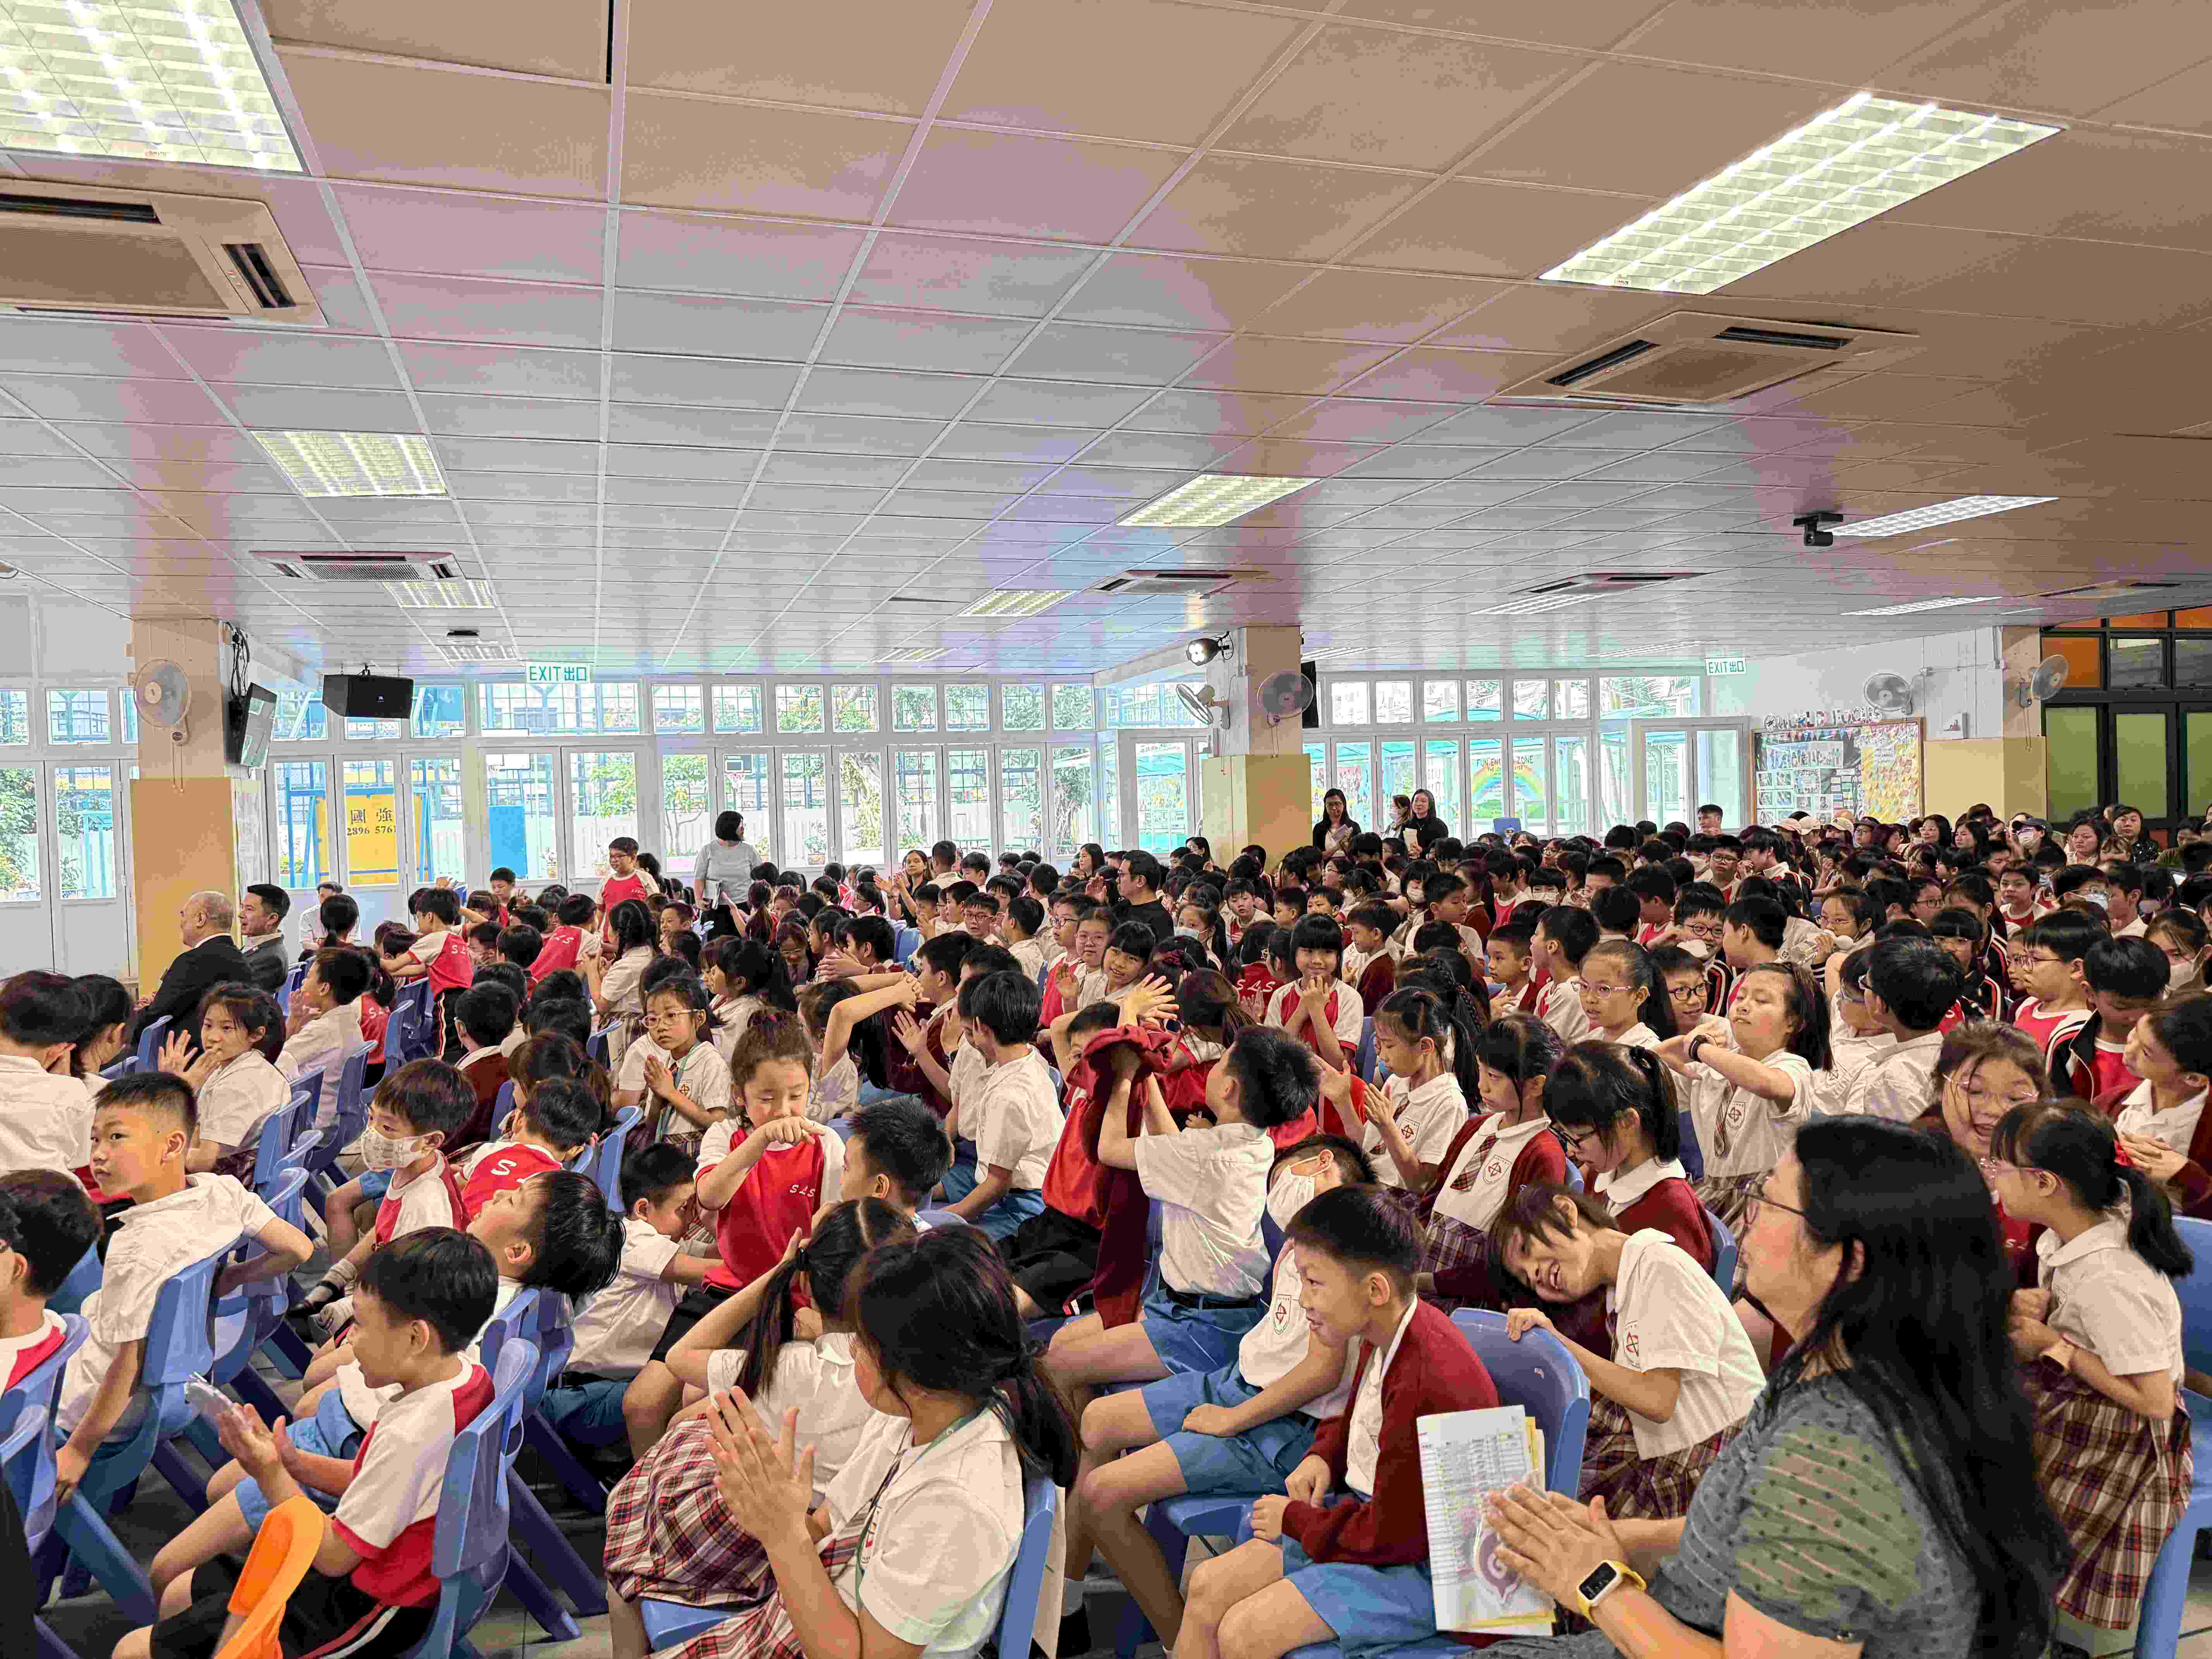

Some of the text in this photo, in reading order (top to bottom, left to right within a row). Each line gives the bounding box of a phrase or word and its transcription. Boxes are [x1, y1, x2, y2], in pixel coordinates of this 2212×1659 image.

[1708, 661, 1745, 673] EXIT 出口
[529, 666, 587, 681] EXIT 出口
[1517, 755, 1534, 764] ZONE
[347, 827, 369, 836] 2896
[790, 1184, 816, 1197] SLS
